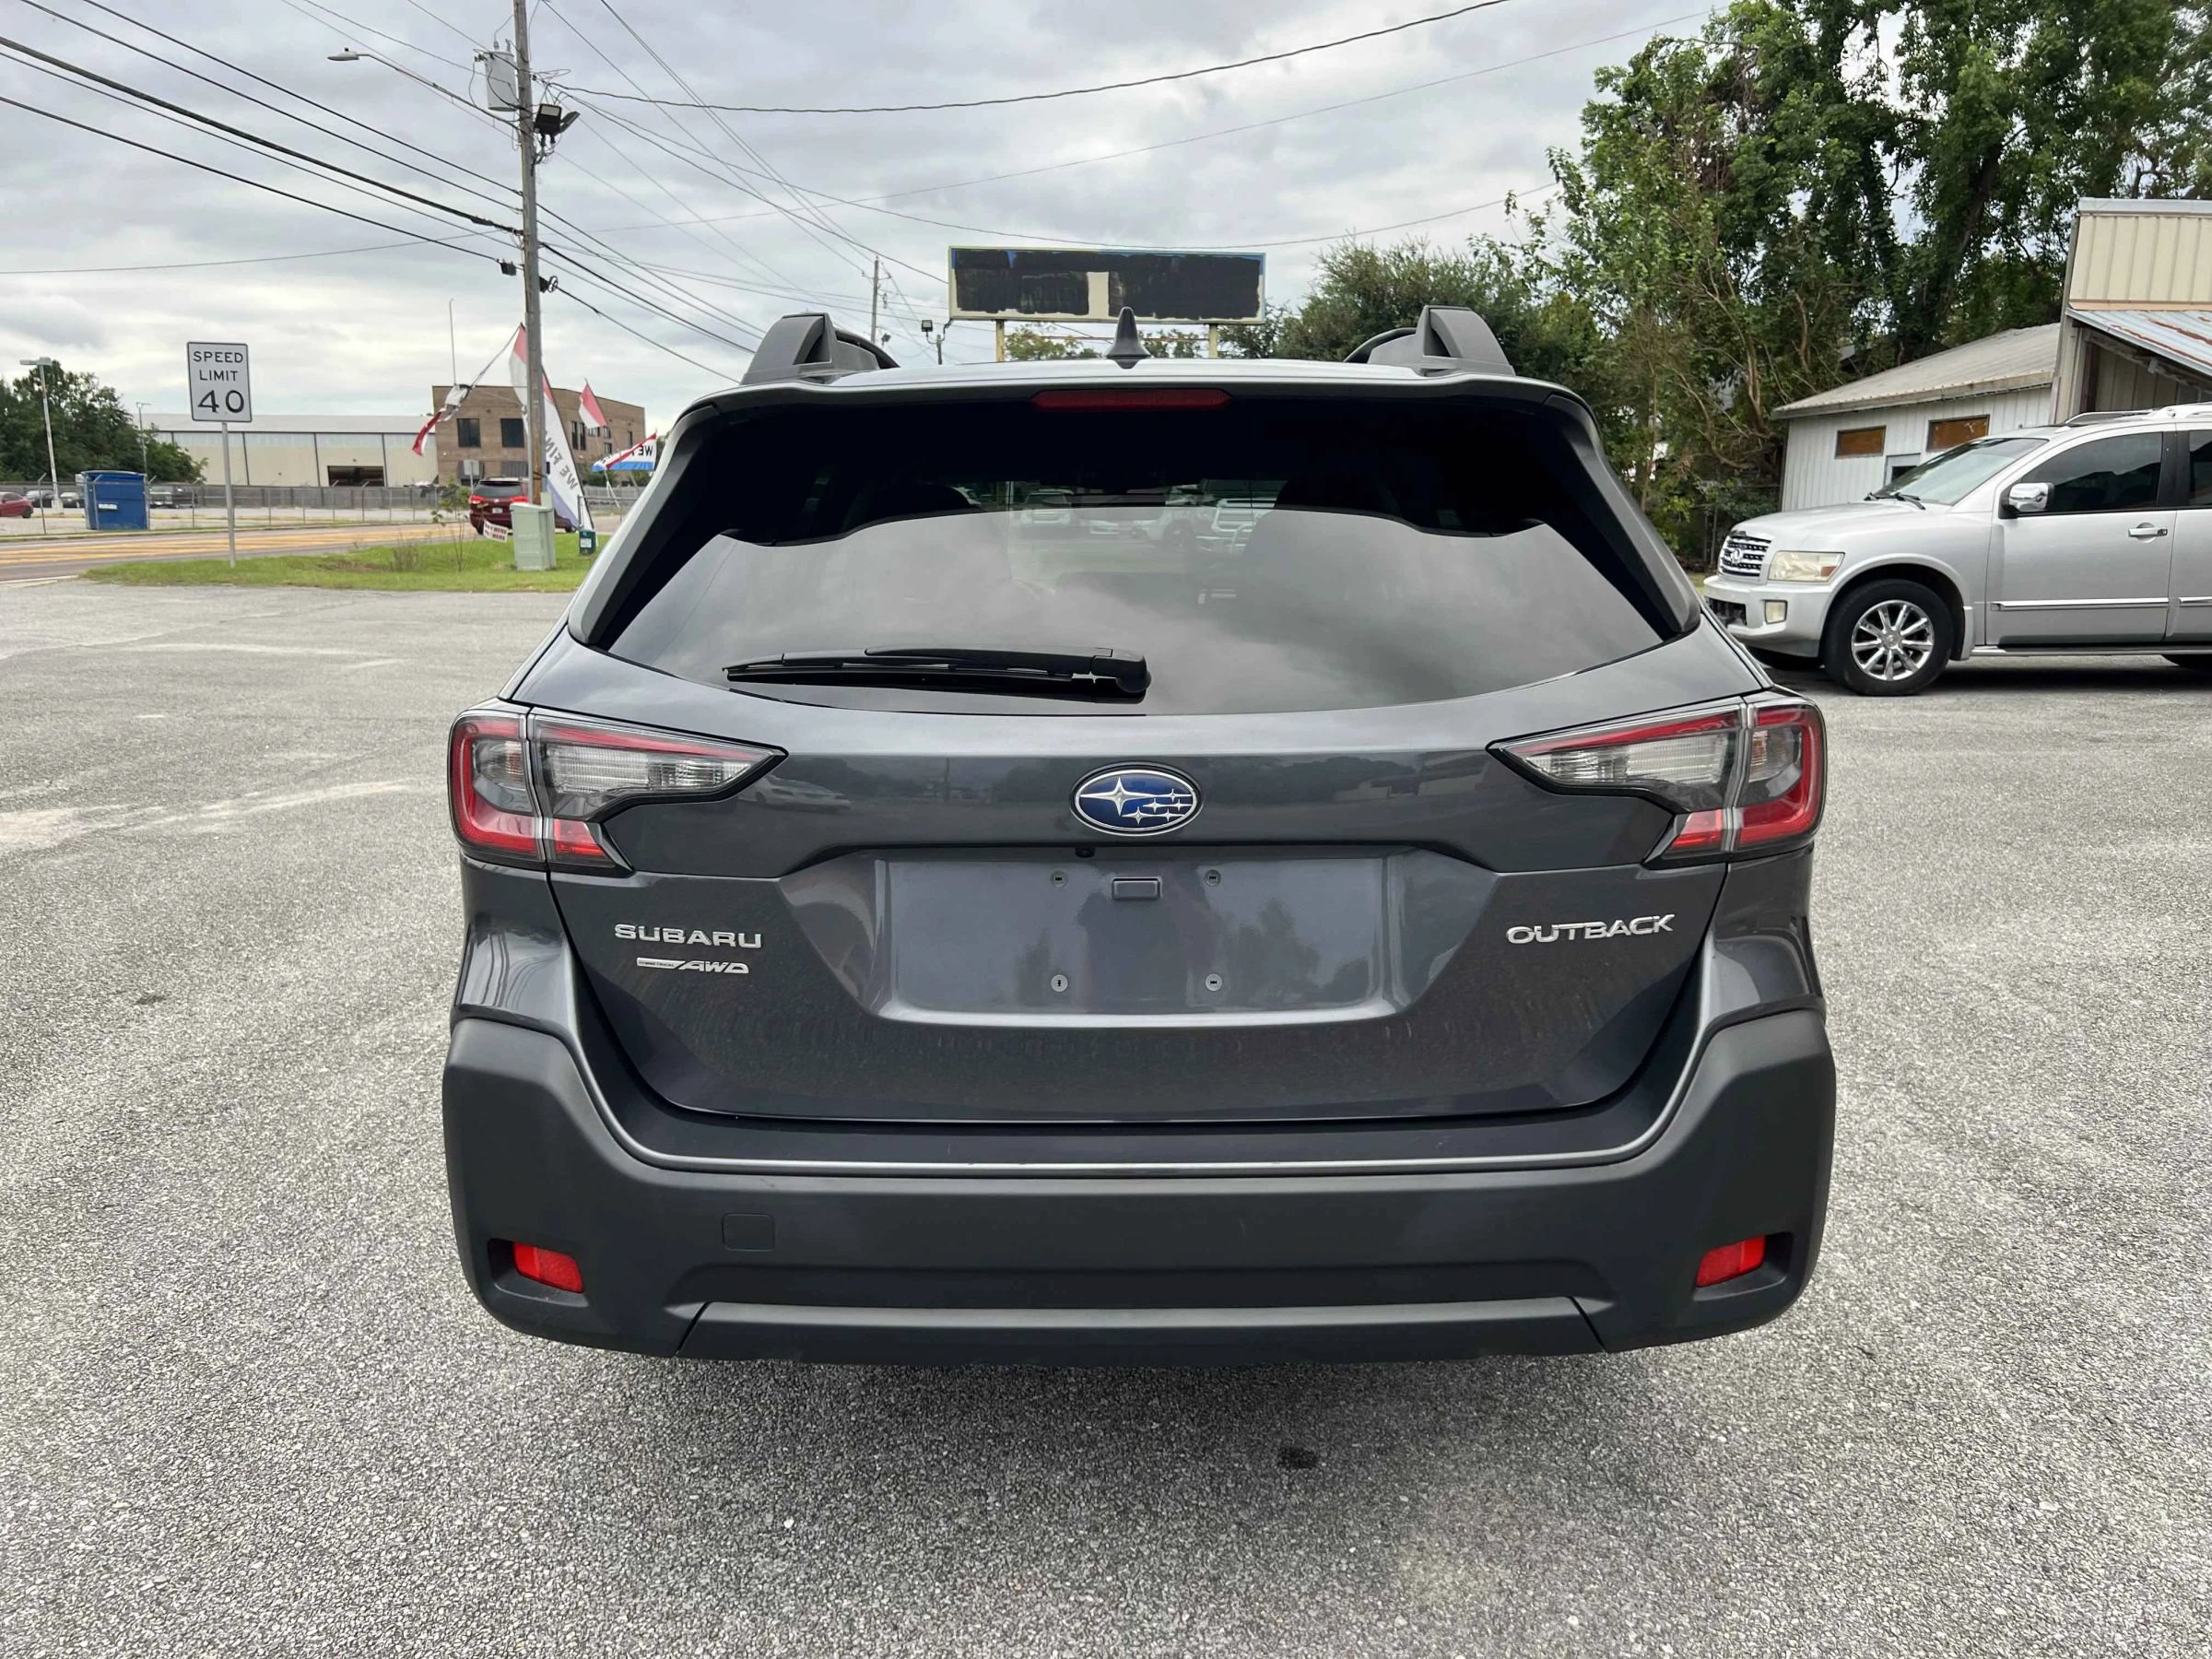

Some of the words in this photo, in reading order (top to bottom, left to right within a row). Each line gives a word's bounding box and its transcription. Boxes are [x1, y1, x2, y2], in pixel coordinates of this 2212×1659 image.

[193, 351, 243, 363] SPEED
[199, 370, 239, 382] LIMIT
[197, 389, 244, 413] 40
[614, 924, 762, 948] SUBARU
[1506, 913, 1675, 944] OUTBACK
[678, 960, 749, 974] AWD
